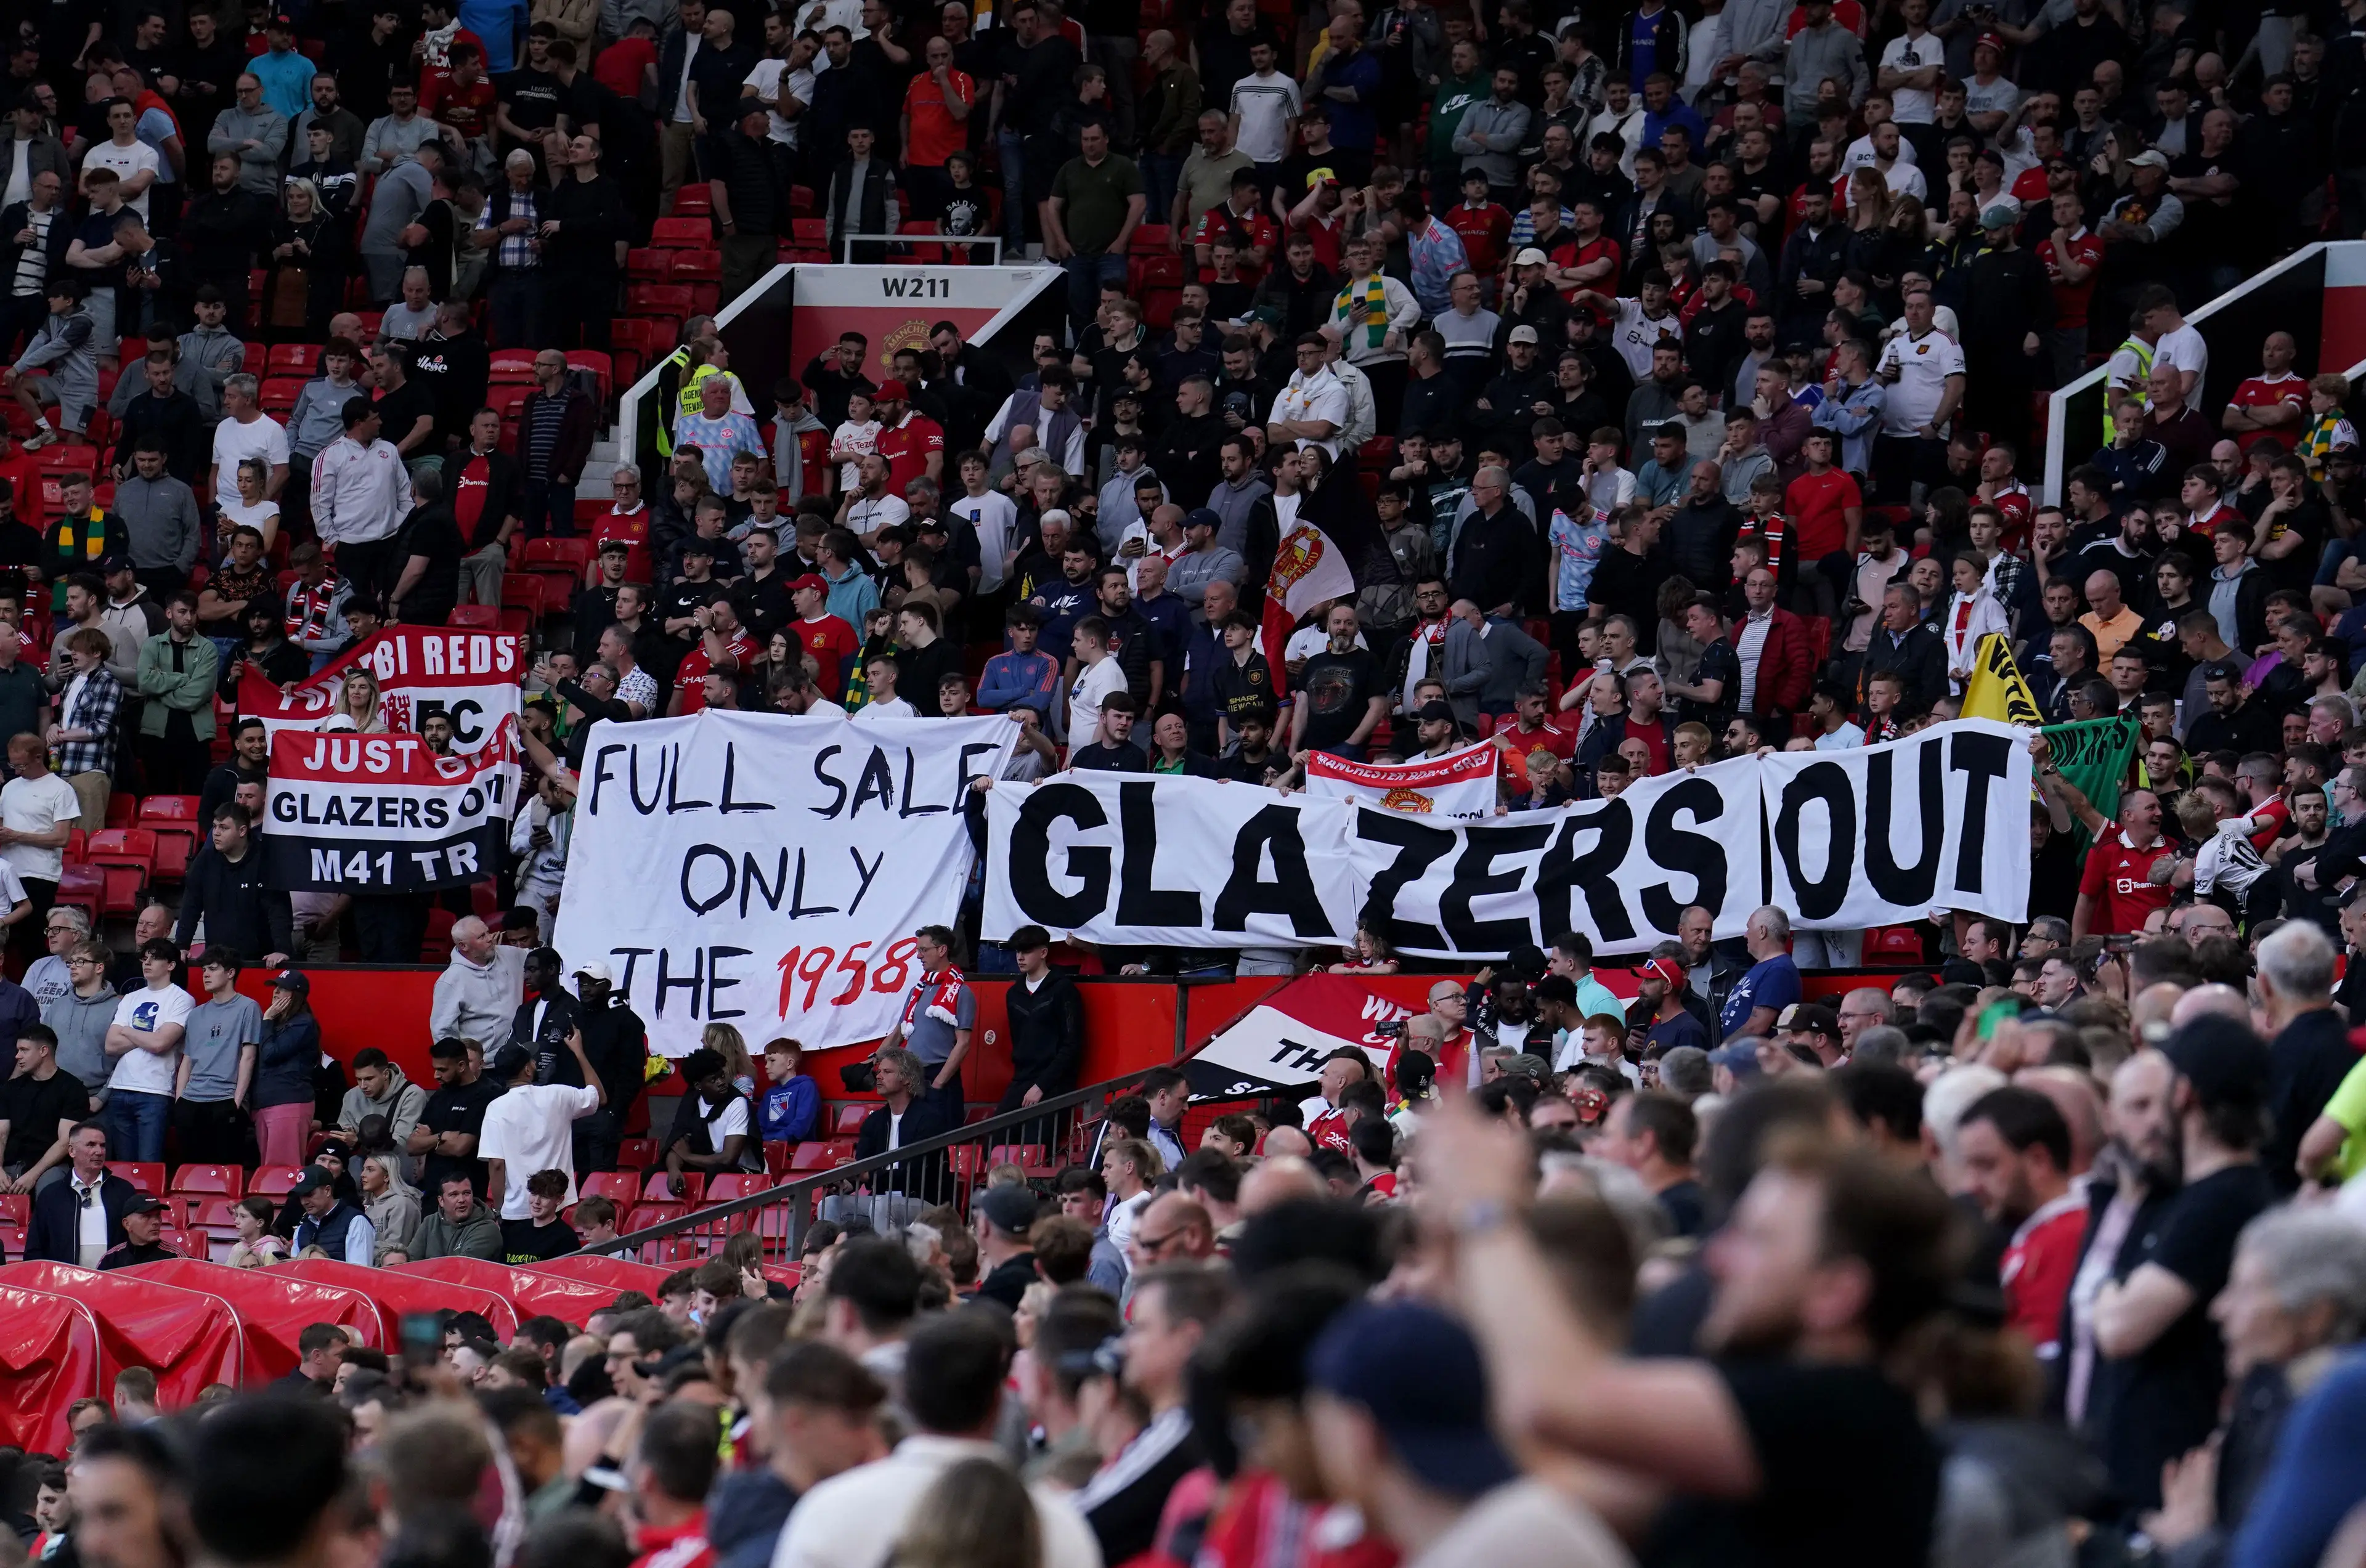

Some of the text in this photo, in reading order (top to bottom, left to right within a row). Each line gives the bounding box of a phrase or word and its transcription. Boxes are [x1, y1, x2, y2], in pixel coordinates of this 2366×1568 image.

[946, 200, 968, 212] BALD
[882, 278, 949, 298] W211
[422, 635, 516, 675] REDS
[682, 676, 709, 684] SHAR
[1229, 694, 1259, 705] SHARP
[303, 738, 418, 773] JUST
[1317, 753, 1406, 782] MANCHESTER
[1452, 750, 1490, 771] BRED
[590, 742, 776, 816] FULL
[808, 743, 1002, 821] SALE
[272, 792, 450, 829] GLAZERS
[1009, 731, 2013, 953] GLAZERS OUT
[2229, 842, 2262, 871] 10
[311, 842, 478, 885] M41 TR
[681, 843, 884, 920] ONLY
[37, 987, 63, 996] BEER
[610, 936, 918, 1022] THE 1958
